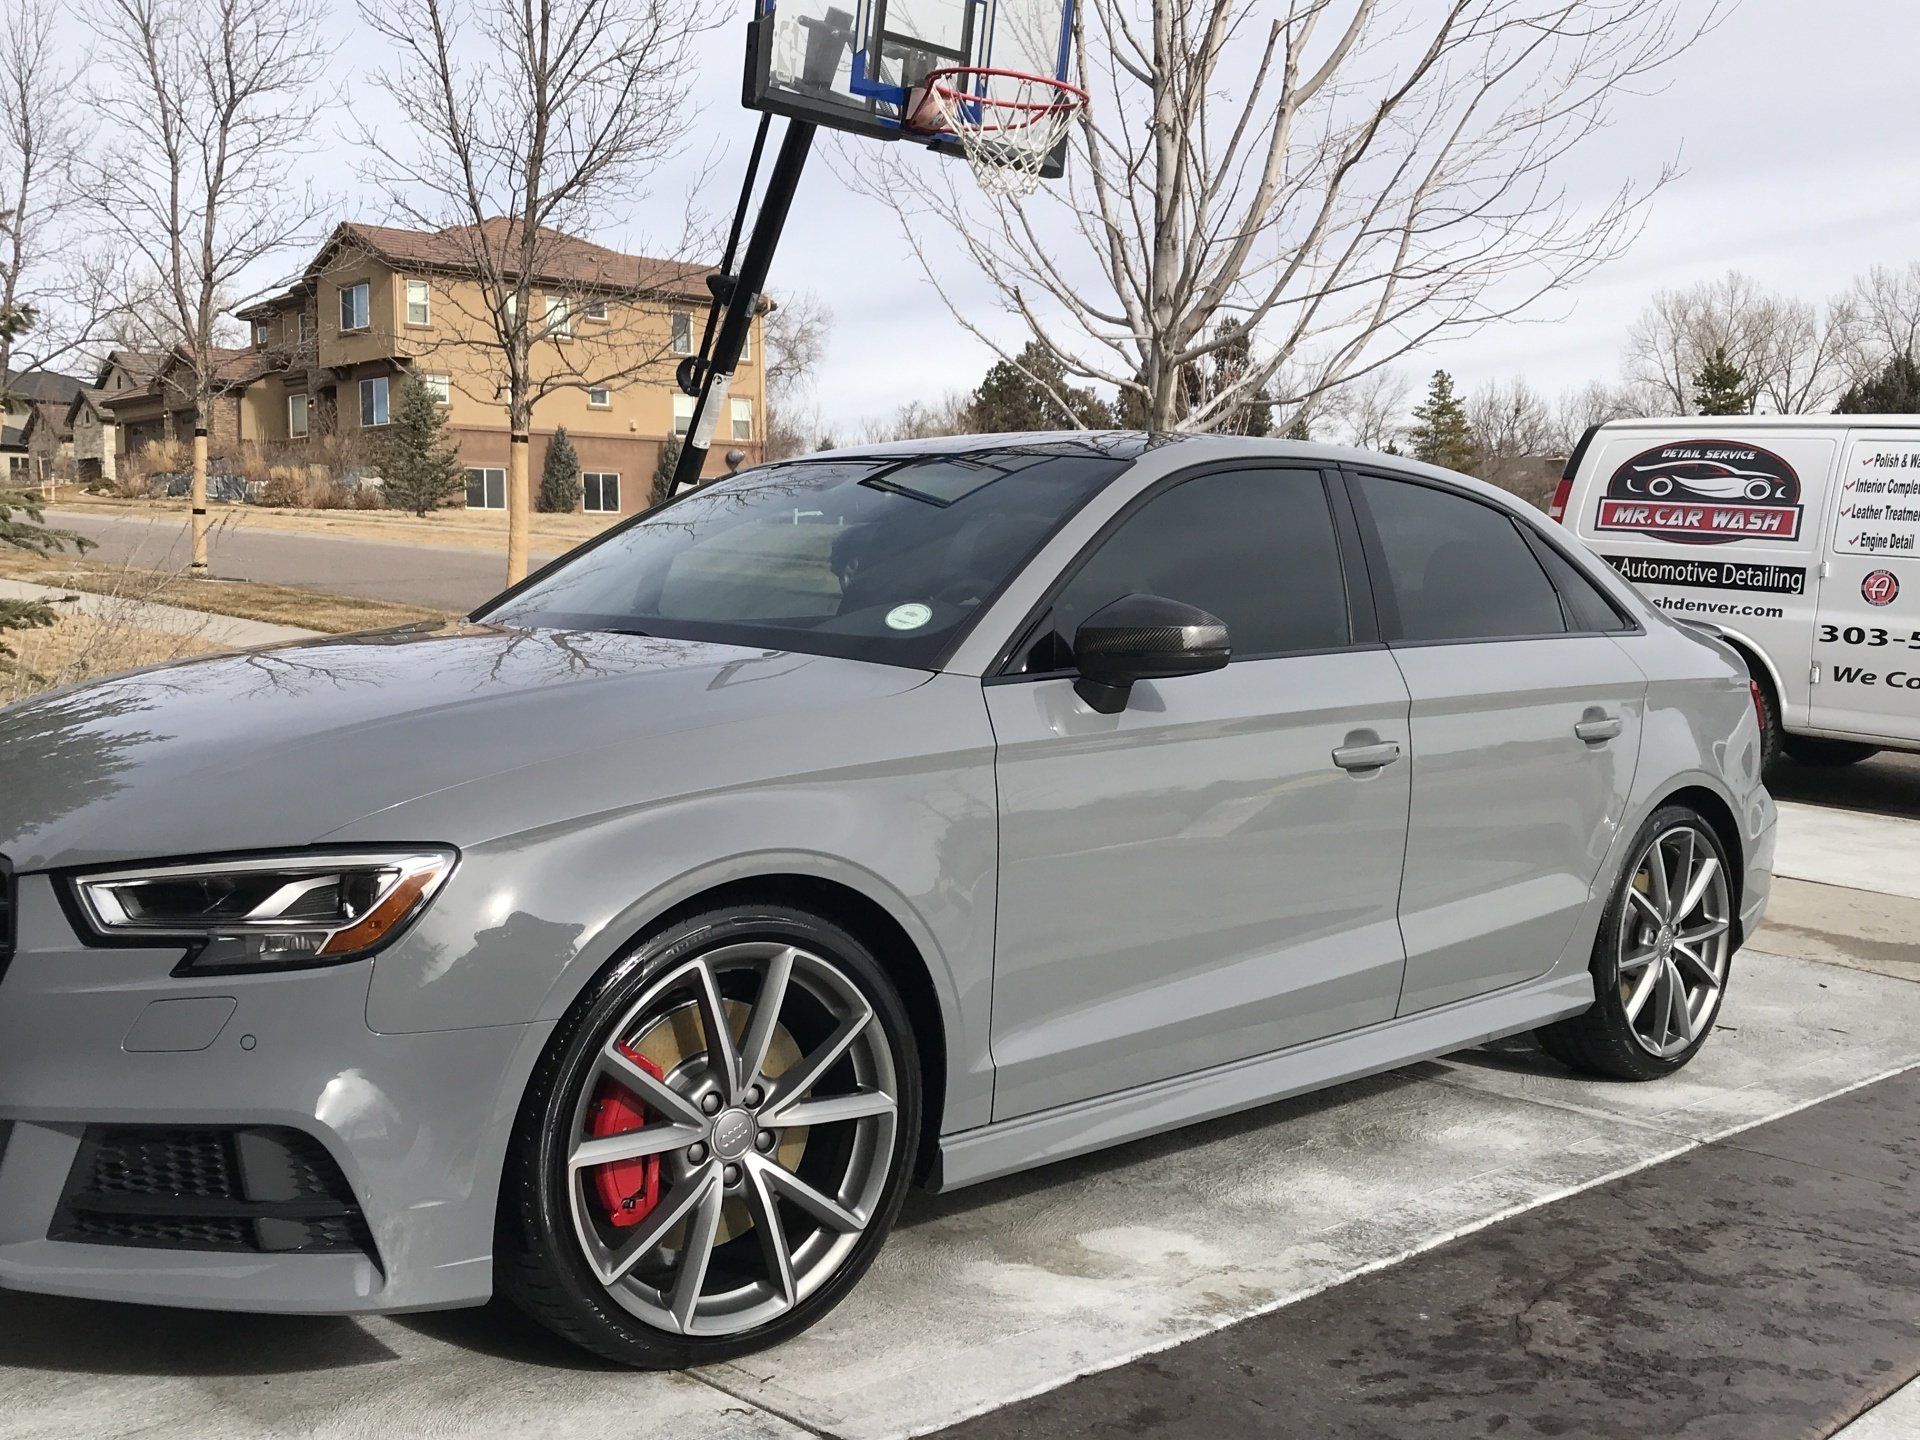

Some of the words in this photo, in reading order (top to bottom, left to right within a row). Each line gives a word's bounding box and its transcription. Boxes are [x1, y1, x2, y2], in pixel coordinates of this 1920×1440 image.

[1661, 448, 1702, 459] DETAIL
[1704, 449, 1758, 460] SERVICE
[1873, 453, 1899, 468] Polish
[1900, 453, 1908, 468] &
[1855, 478, 1886, 493] Interior
[1711, 508, 1784, 532] WASH
[1851, 503, 1883, 520] Leather
[1860, 532, 1888, 551] Engine
[1889, 533, 1915, 550] Detail
[1620, 557, 1718, 583] Automotive
[1722, 564, 1803, 594] Detailing
[1818, 624, 1920, 650] 303-5
[1833, 665, 1877, 685] We
